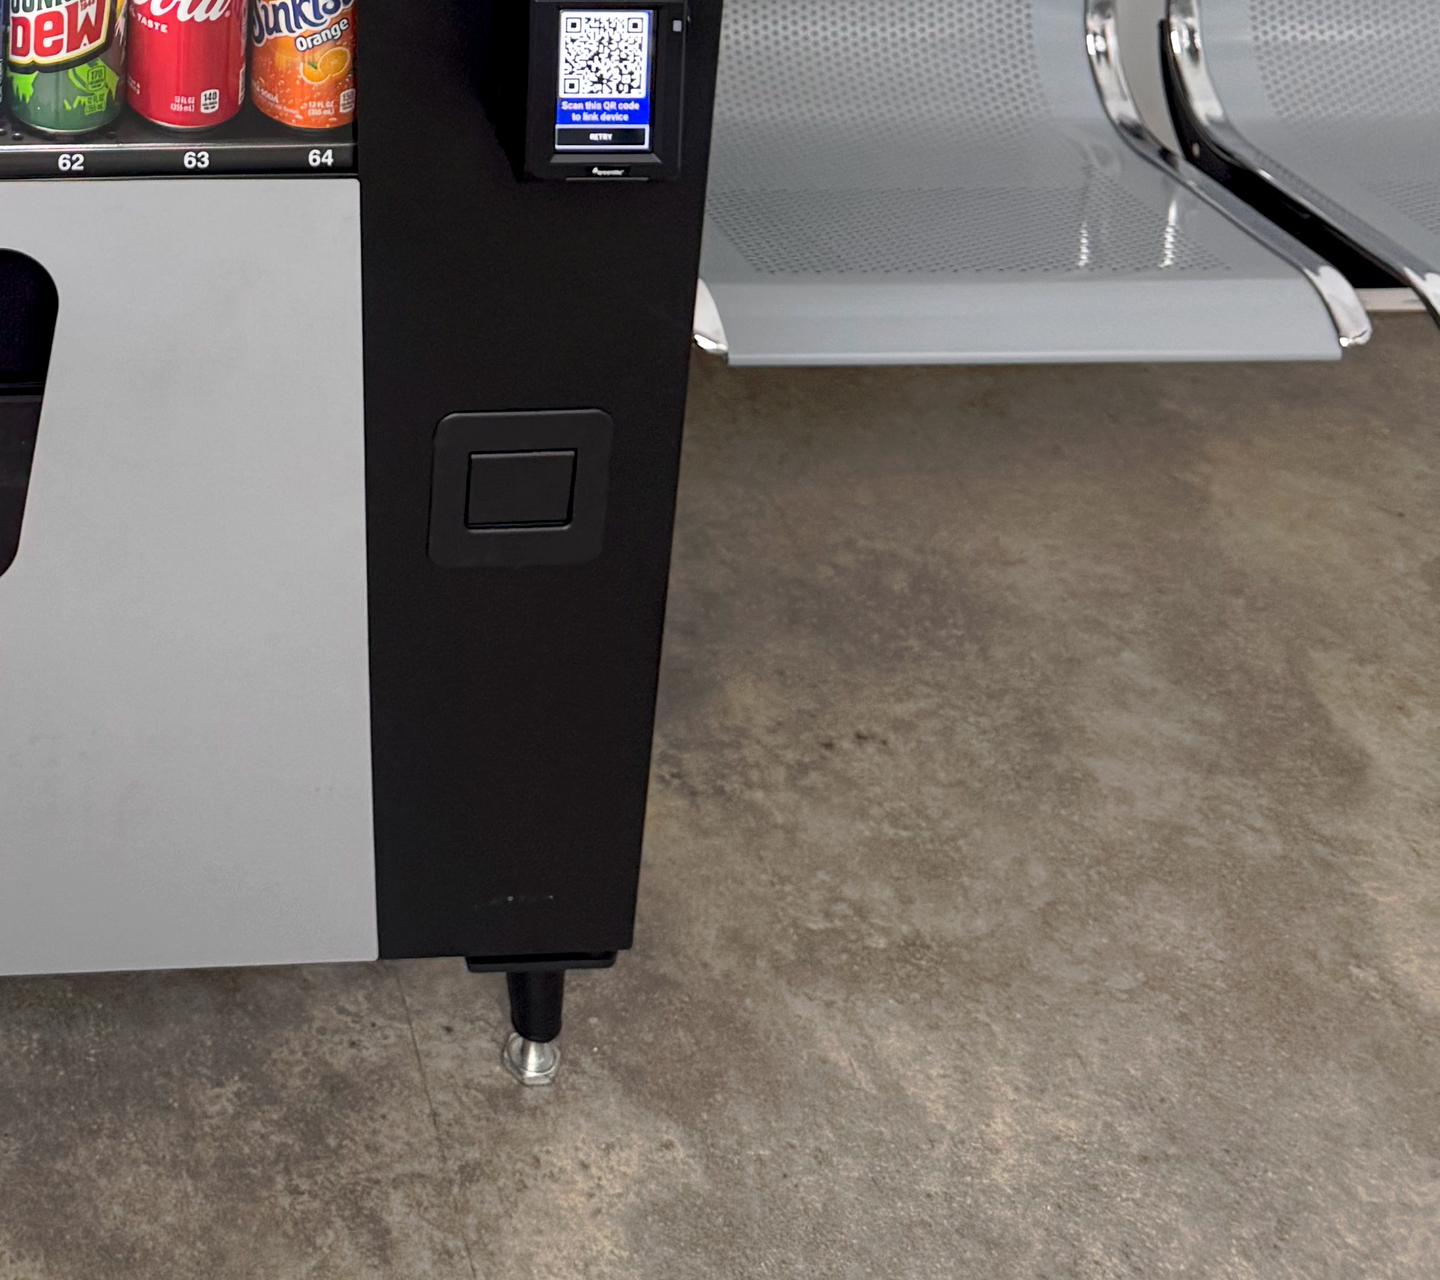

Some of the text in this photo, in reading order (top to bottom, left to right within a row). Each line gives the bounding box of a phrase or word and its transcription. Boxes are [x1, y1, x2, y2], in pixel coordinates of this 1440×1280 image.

[137, 13, 169, 34] TASTE
[295, 17, 349, 52] Orange
[203, 91, 217, 102] 140
[561, 100, 640, 111] Scan this QR code
[571, 111, 629, 122] to link device
[58, 153, 85, 171] 62
[183, 151, 210, 169] 63
[308, 148, 334, 166] 64
